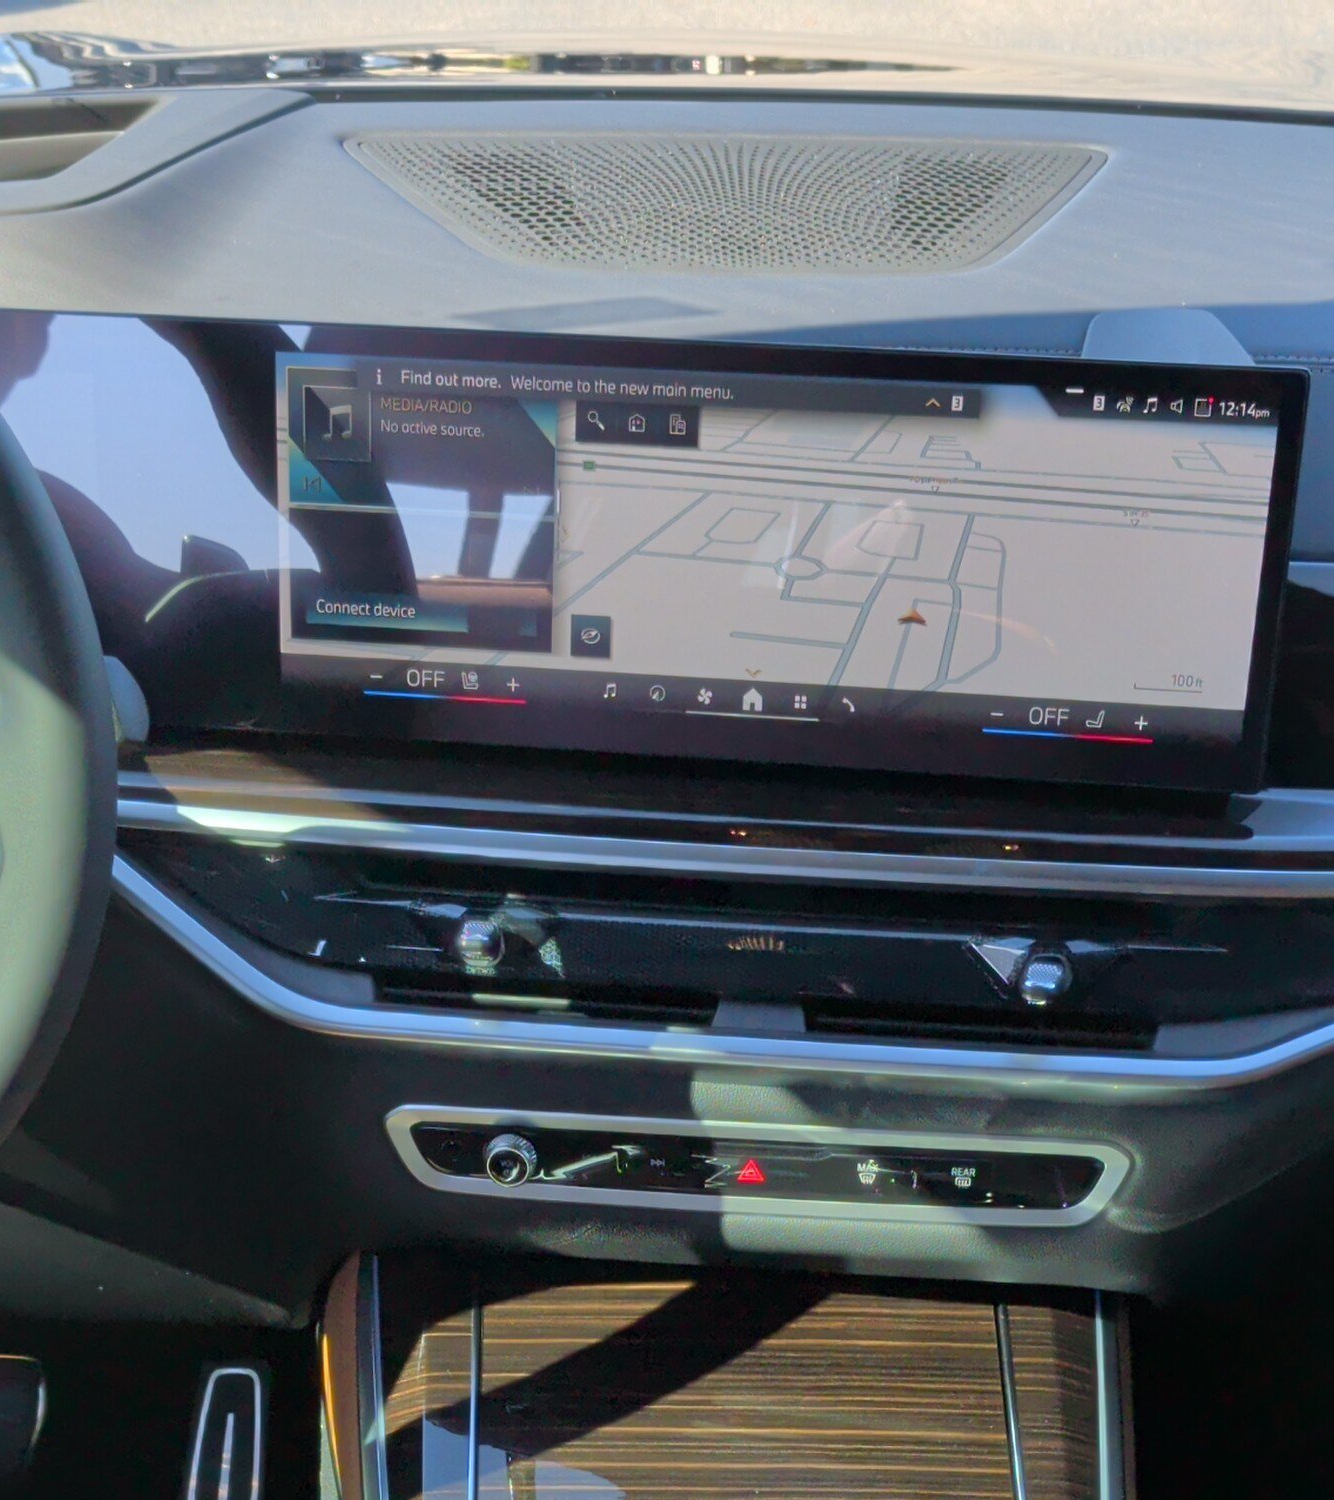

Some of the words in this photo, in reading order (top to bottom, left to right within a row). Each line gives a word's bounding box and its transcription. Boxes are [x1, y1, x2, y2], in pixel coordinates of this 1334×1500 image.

[400, 369, 432, 386] Find
[435, 374, 458, 387] out
[461, 375, 502, 389] more.
[510, 374, 573, 393] Welcome
[577, 377, 591, 393] to
[594, 378, 616, 395] the
[620, 382, 649, 396] new
[652, 384, 686, 398] main
[690, 386, 734, 400] menu.
[380, 397, 472, 415] MEDIA/RADIO
[1219, 402, 1270, 418] 12:14pm
[380, 419, 399, 434] No
[401, 421, 437, 435] active
[440, 424, 485, 438] source.
[316, 599, 370, 617] Connect
[373, 602, 416, 619] device
[406, 668, 446, 689] OFF
[1171, 673, 1195, 689] 100
[1028, 706, 1071, 727] OFF
[950, 1167, 976, 1178] REAR
